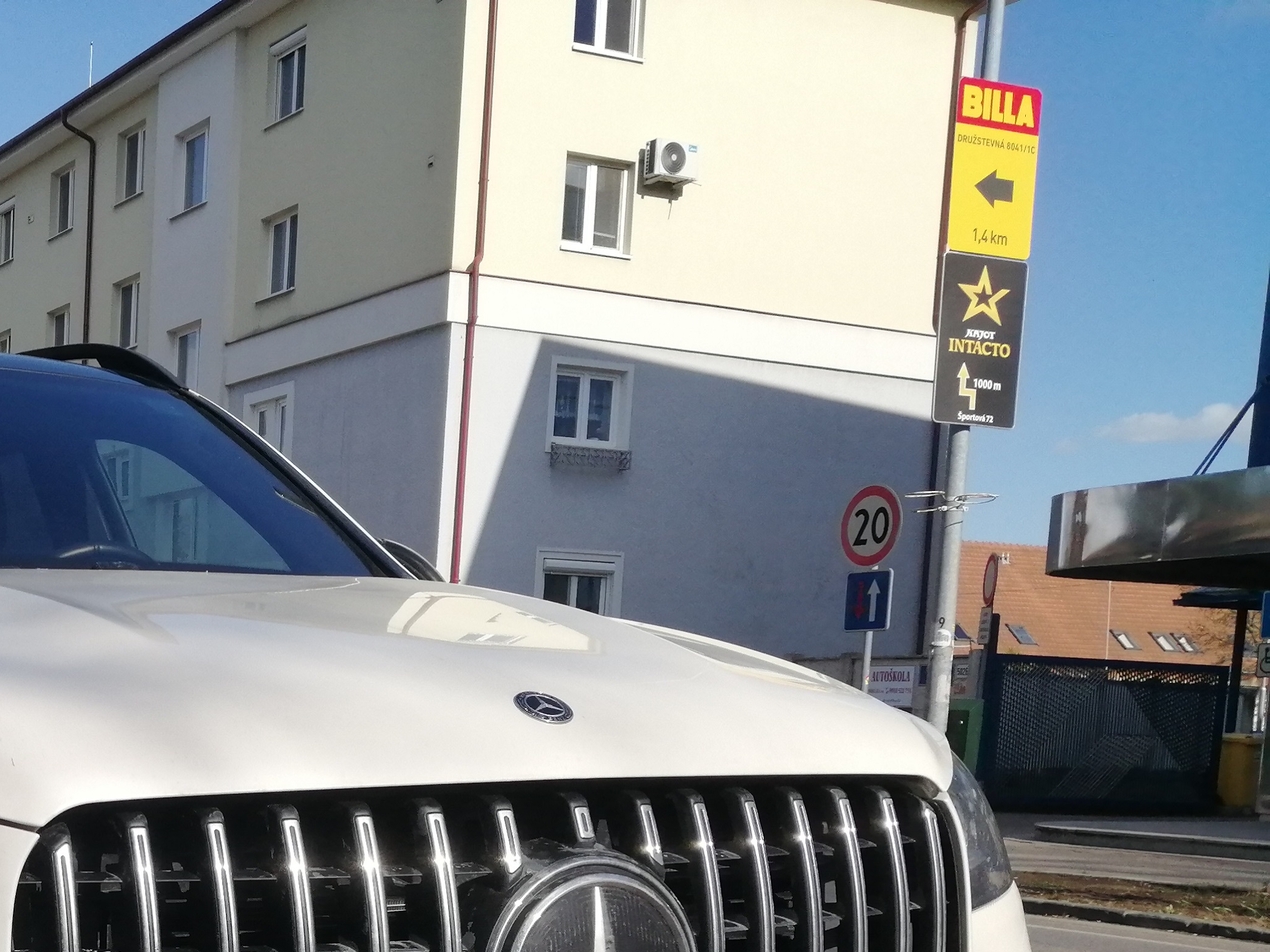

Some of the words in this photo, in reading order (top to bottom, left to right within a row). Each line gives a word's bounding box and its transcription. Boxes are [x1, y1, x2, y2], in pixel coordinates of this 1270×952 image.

[962, 84, 1035, 128] BILLA
[957, 134, 1005, 149] DRUŽSTEVNÁ
[1006, 142, 1036, 154] 8041/1C
[973, 228, 988, 244] 1,4
[990, 230, 1008, 246] km
[948, 337, 1011, 358] INTACTO
[973, 378, 993, 390] 1000
[993, 382, 1001, 391] m
[957, 410, 986, 422] Športová
[985, 414, 994, 423] 72
[852, 506, 890, 547] 20
[938, 616, 946, 629] 9
[871, 668, 911, 683] AUTOŠKOLA
